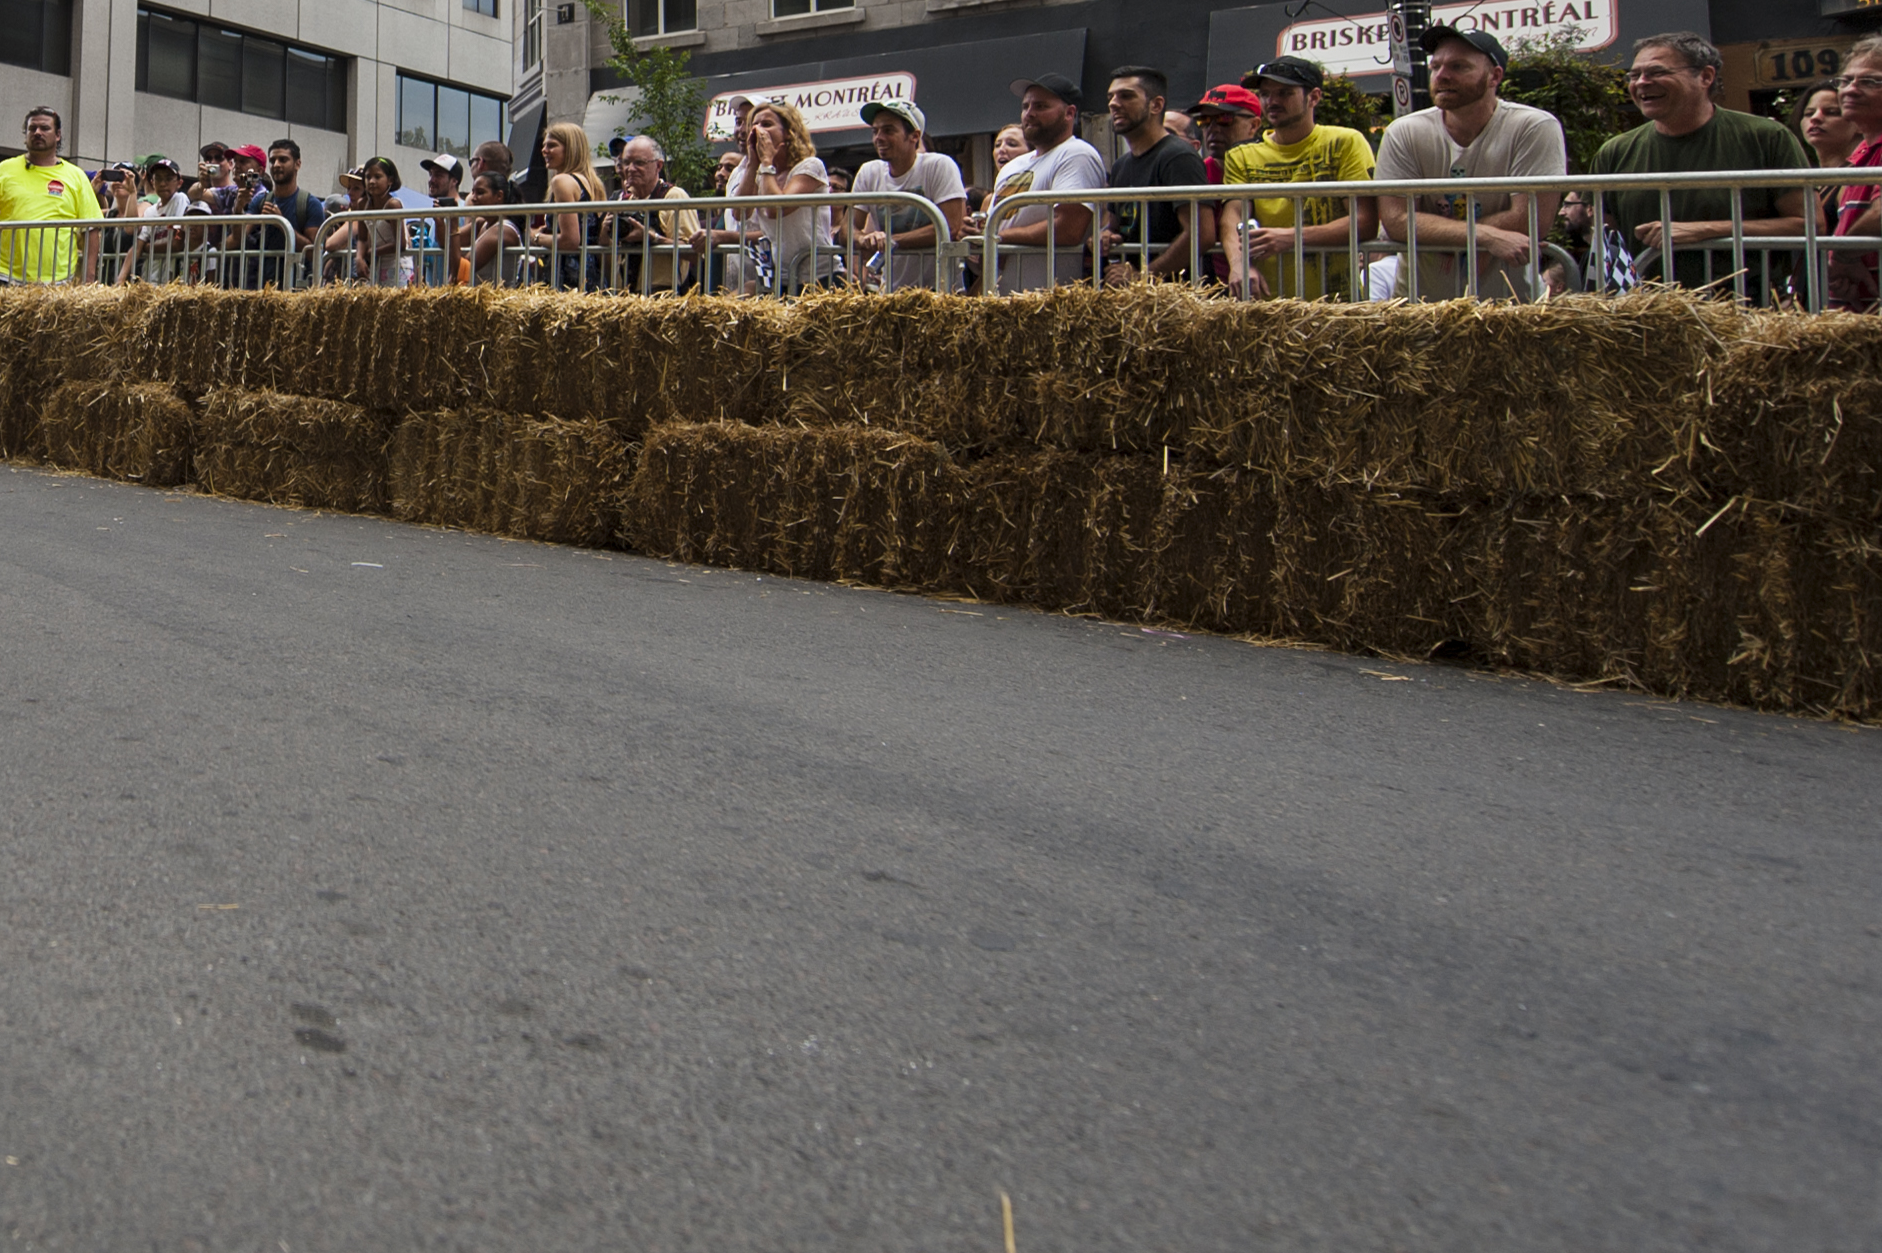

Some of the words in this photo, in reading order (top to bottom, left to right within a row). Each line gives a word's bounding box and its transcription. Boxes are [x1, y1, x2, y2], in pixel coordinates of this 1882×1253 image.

[1291, 22, 1390, 52] BRISKE
[1431, 0, 1600, 32] ONTRÉAL
[794, 81, 905, 109] MONTRÉAL
